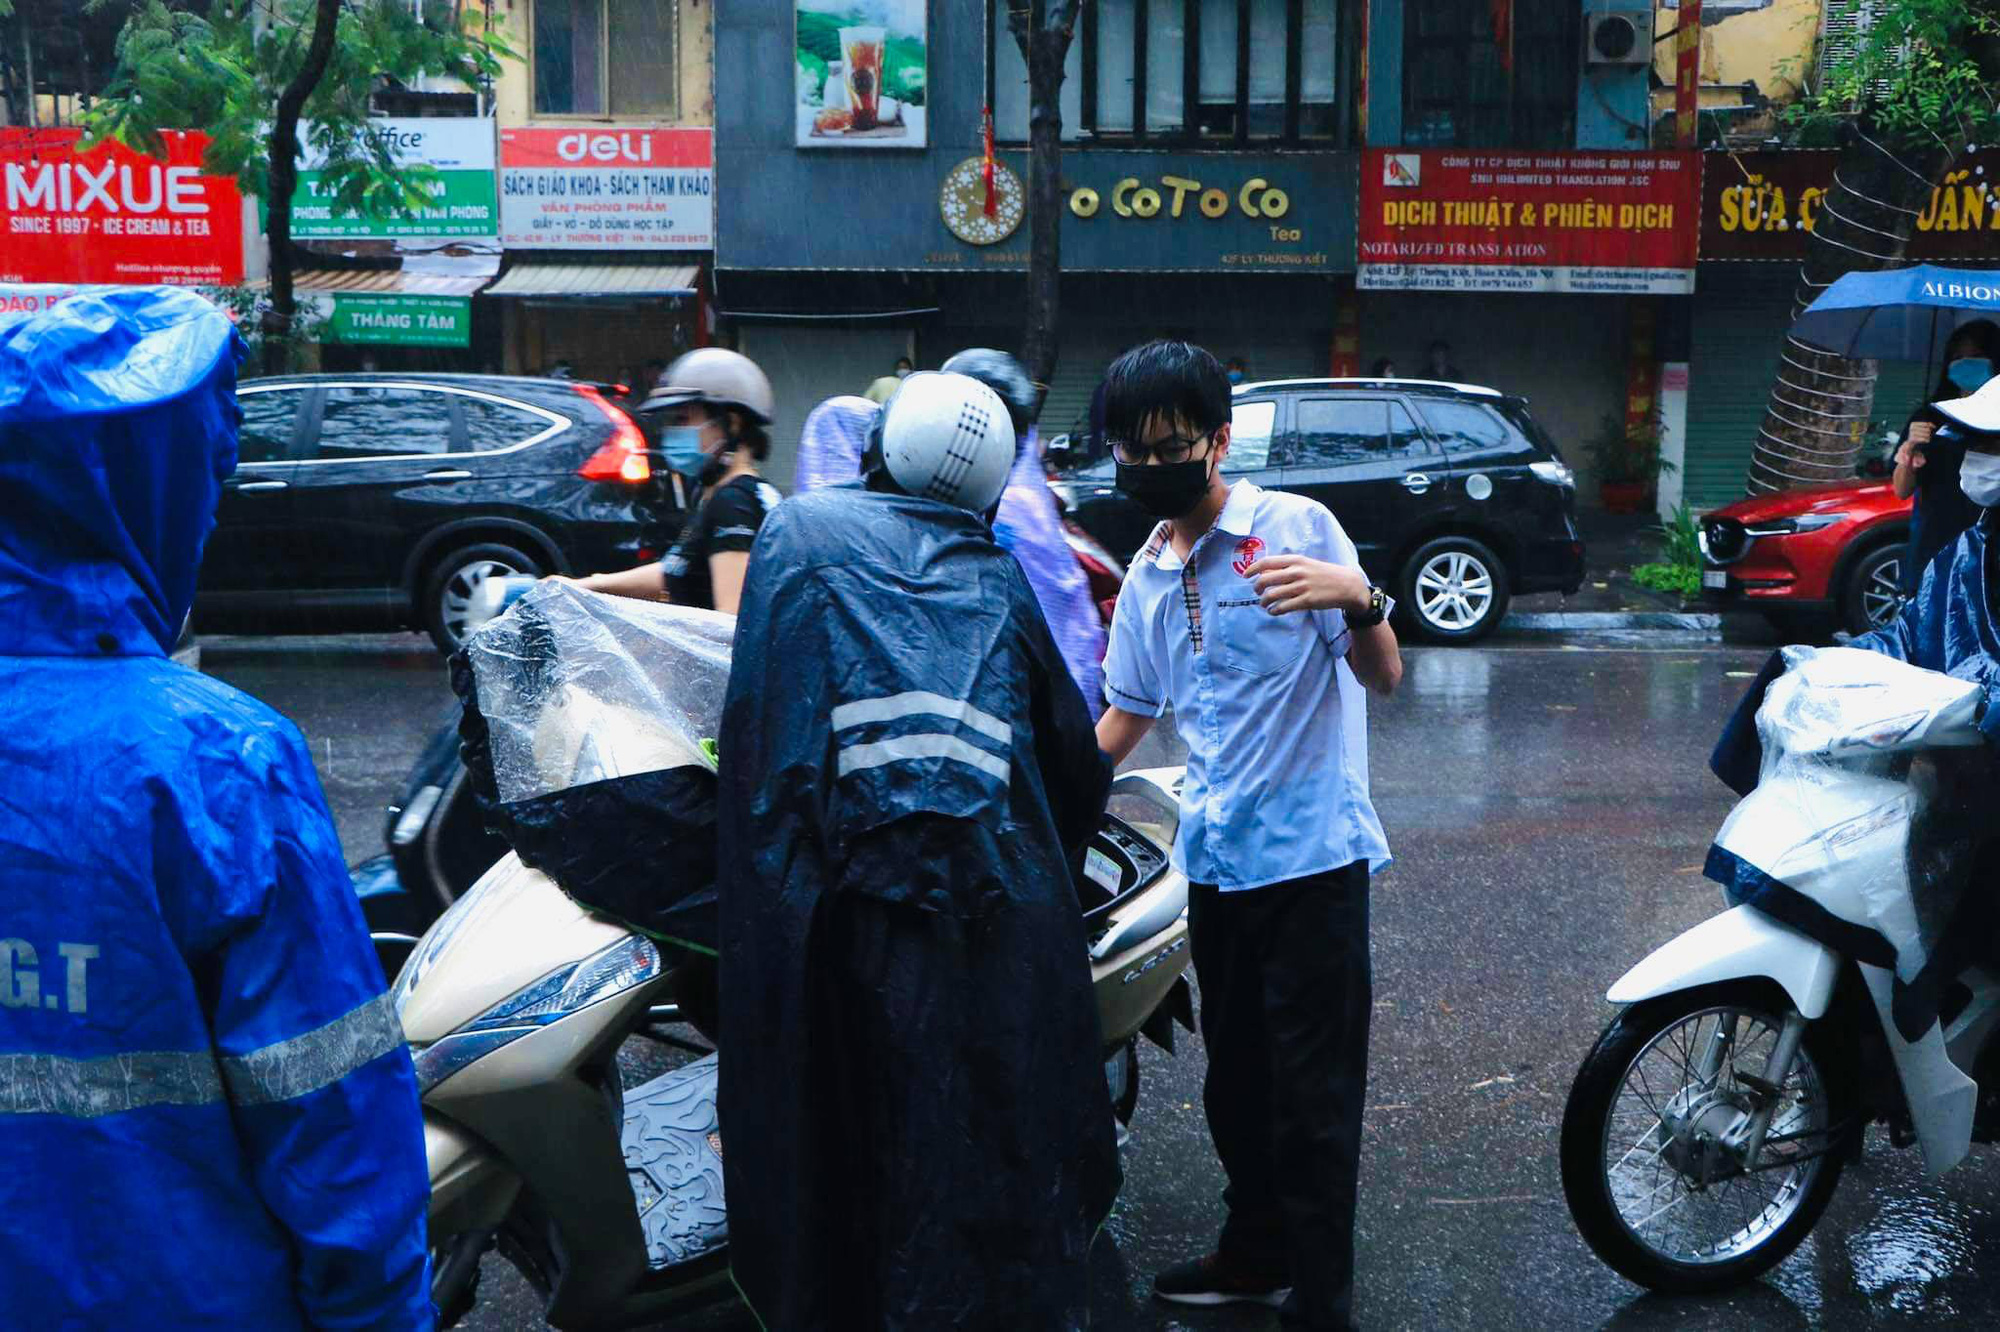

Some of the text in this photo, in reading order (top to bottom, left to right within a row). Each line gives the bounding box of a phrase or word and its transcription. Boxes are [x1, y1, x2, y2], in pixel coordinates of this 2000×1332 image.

[557, 133, 652, 162] deli
[4, 162, 210, 214] MIXUE
[504, 171, 534, 196] SÁCH
[538, 170, 566, 196] GIÁO
[570, 175, 602, 196] KHOA
[610, 170, 640, 196] SÁCH
[644, 174, 675, 196] THAM
[1383, 195, 1674, 233] DỊCH THUẬT & PHIÊN DỊCH
[1720, 174, 1788, 232] SỮA
[10, 217, 51, 234] SINCE
[55, 217, 90, 234] 1997
[103, 218, 123, 235] ICE
[126, 218, 170, 235] CREAM
[172, 220, 183, 235] &
[185, 218, 210, 236] TEA
[1269, 226, 1301, 241] Tea
[1362, 242, 1547, 257] NOTARIZED TRANSLATION
